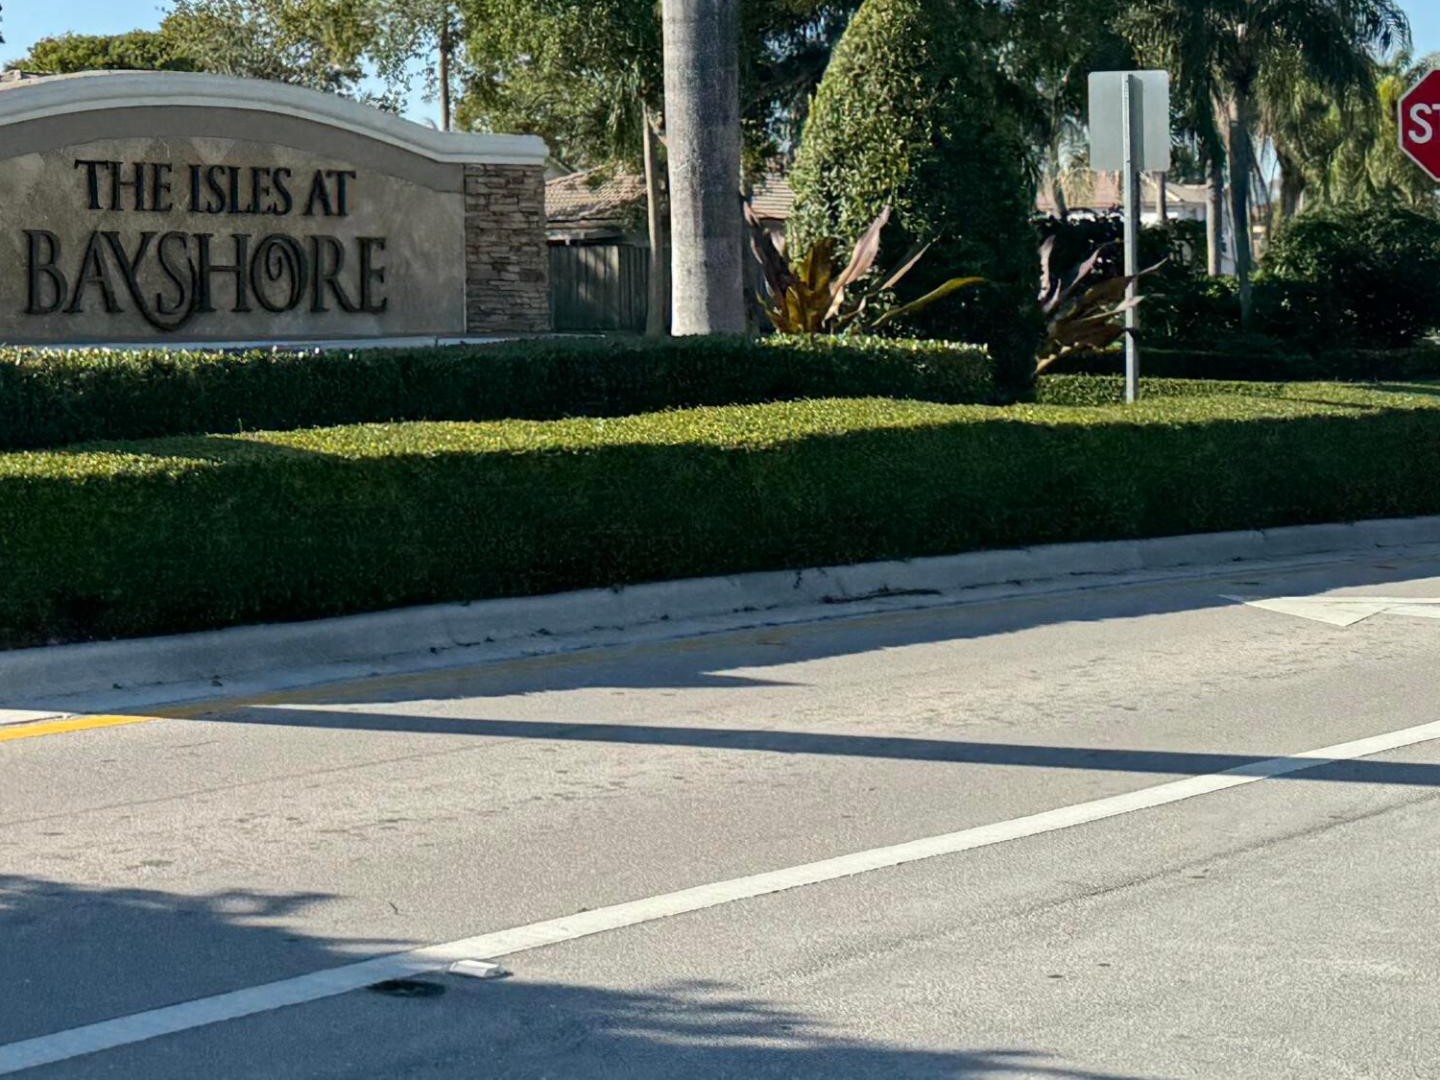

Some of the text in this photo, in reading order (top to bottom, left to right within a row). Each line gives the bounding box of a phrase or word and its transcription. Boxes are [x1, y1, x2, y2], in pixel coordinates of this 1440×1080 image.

[74, 159, 357, 217] THE ISLES AT
[22, 228, 388, 332] BAYSHORE
